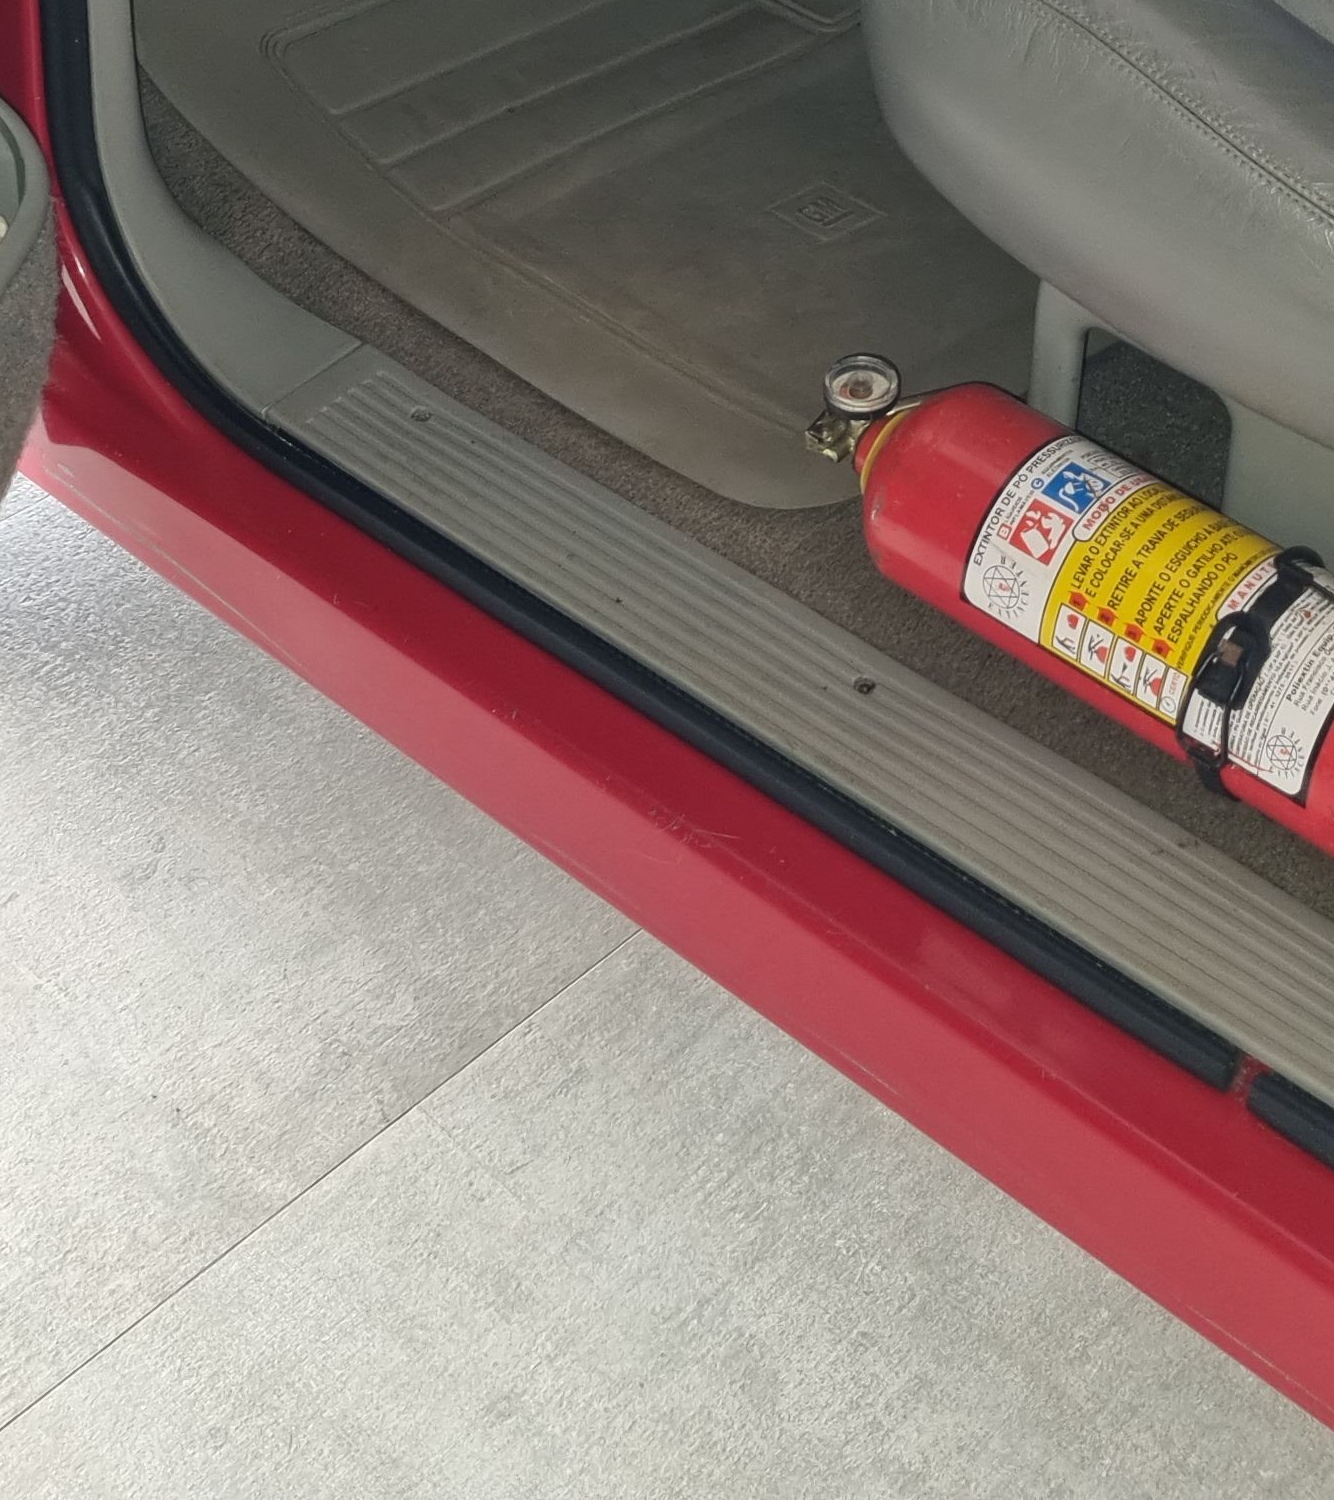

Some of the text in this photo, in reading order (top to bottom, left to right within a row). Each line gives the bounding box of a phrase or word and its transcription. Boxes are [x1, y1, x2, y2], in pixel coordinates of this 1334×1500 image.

[974, 504, 1004, 565] EXTINTOR
[1002, 489, 1016, 505] DE
[1012, 471, 1028, 488] PÓ
[1083, 494, 1115, 530] MODO
[1130, 518, 1141, 530] A
[1071, 555, 1094, 588] LEVAR
[1089, 545, 1100, 556] O
[1096, 505, 1133, 546] EXTINTOR
[1090, 527, 1135, 588] COLOCAR-SE
[1133, 557, 1144, 569] A
[1138, 527, 1169, 560] TRAVA
[1086, 588, 1095, 599] E
[1107, 567, 1136, 609] RETIRE
[1135, 580, 1165, 626] APONTE
[1161, 571, 1171, 583] O
[1167, 531, 1207, 573] ESGUICHO
[1153, 587, 1184, 633] APERTE
[1179, 577, 1190, 590] O
[1187, 541, 1223, 579] GATILHO
[1167, 569, 1220, 643] ESPALHANDO
[1215, 561, 1226, 573] O
[1286, 658, 1315, 701] Poliextin
